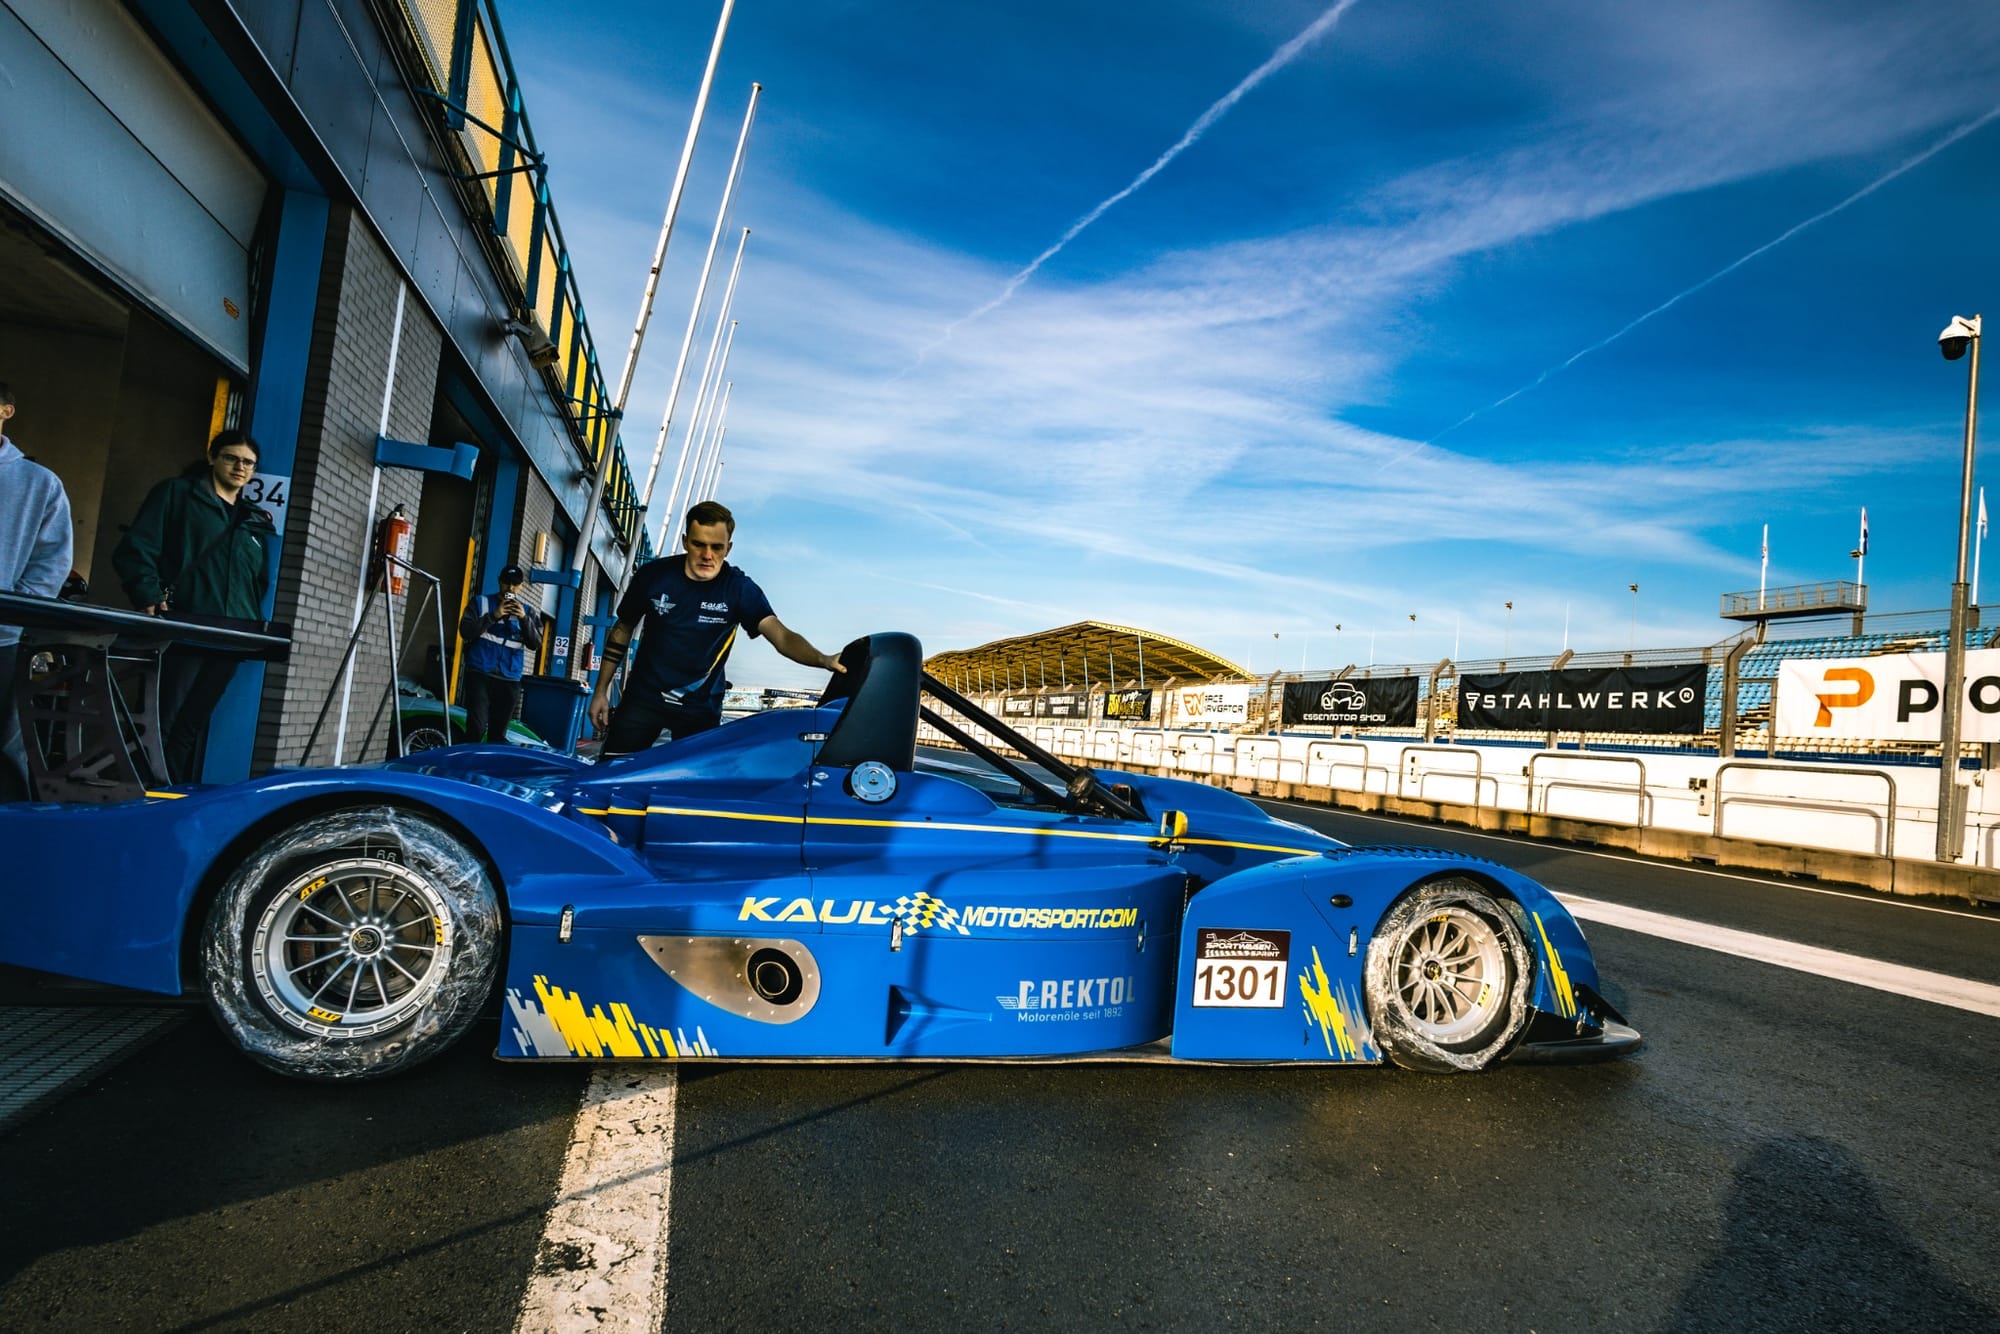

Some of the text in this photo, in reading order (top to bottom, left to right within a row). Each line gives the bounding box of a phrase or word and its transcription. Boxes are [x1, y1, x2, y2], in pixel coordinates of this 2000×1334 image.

[244, 478, 285, 507] 34
[555, 638, 569, 648] 32
[592, 656, 601, 664] 31
[1897, 676, 2000, 722] po
[1360, 713, 1386, 722] SHOW
[376, 849, 397, 862] RR
[299, 876, 328, 900] ATS
[738, 896, 1138, 929] KAUL MOTORSPORT.COM
[1041, 976, 1136, 1010] REKTOL
[1198, 965, 1279, 1001] 1301
[1018, 1006, 1123, 1022] Motorenöle seit 1892
